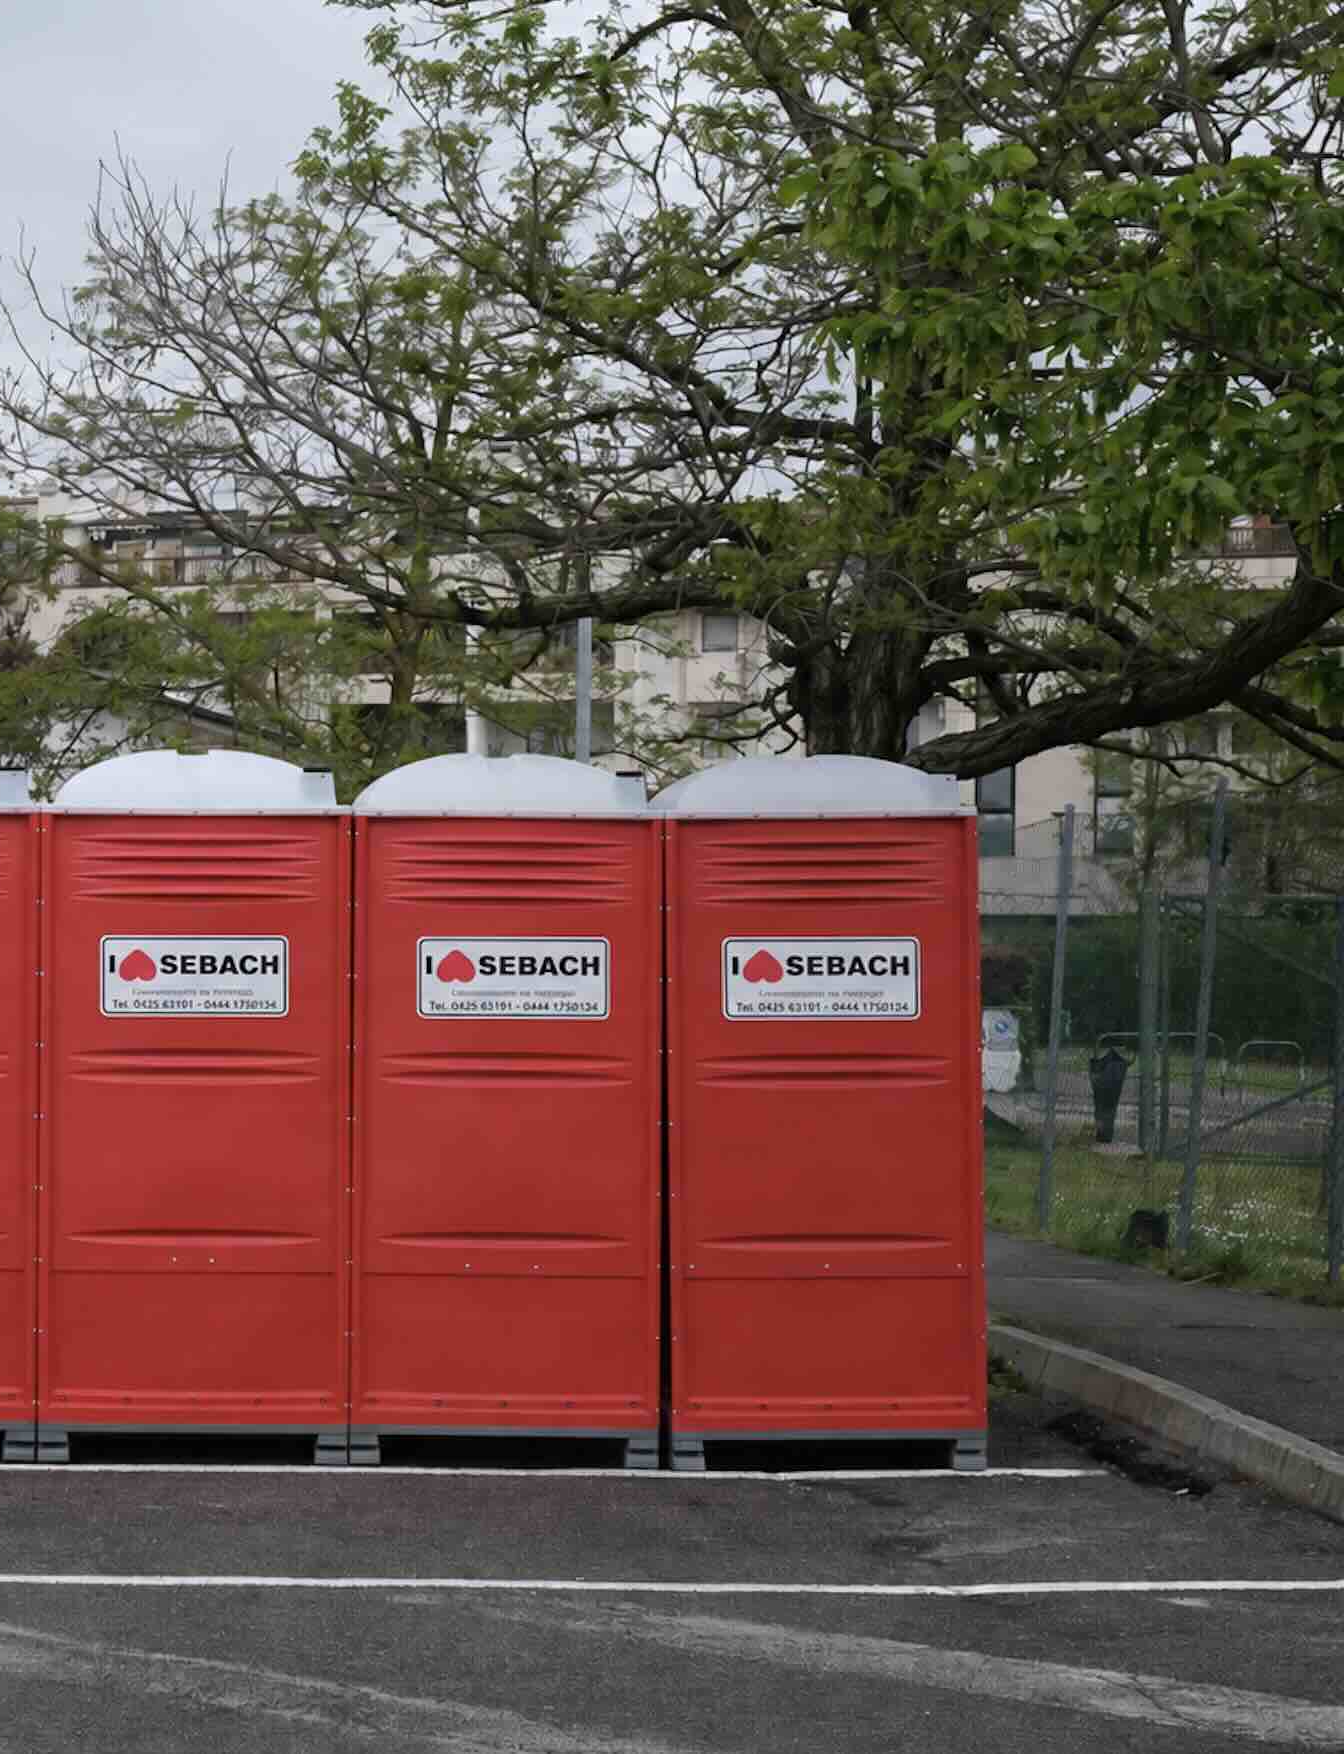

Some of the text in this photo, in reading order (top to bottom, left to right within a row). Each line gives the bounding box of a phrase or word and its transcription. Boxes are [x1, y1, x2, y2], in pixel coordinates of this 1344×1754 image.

[109, 955, 278, 974] I SEBACH
[426, 956, 600, 976] I SEBACH
[732, 956, 910, 976] I SEBACH
